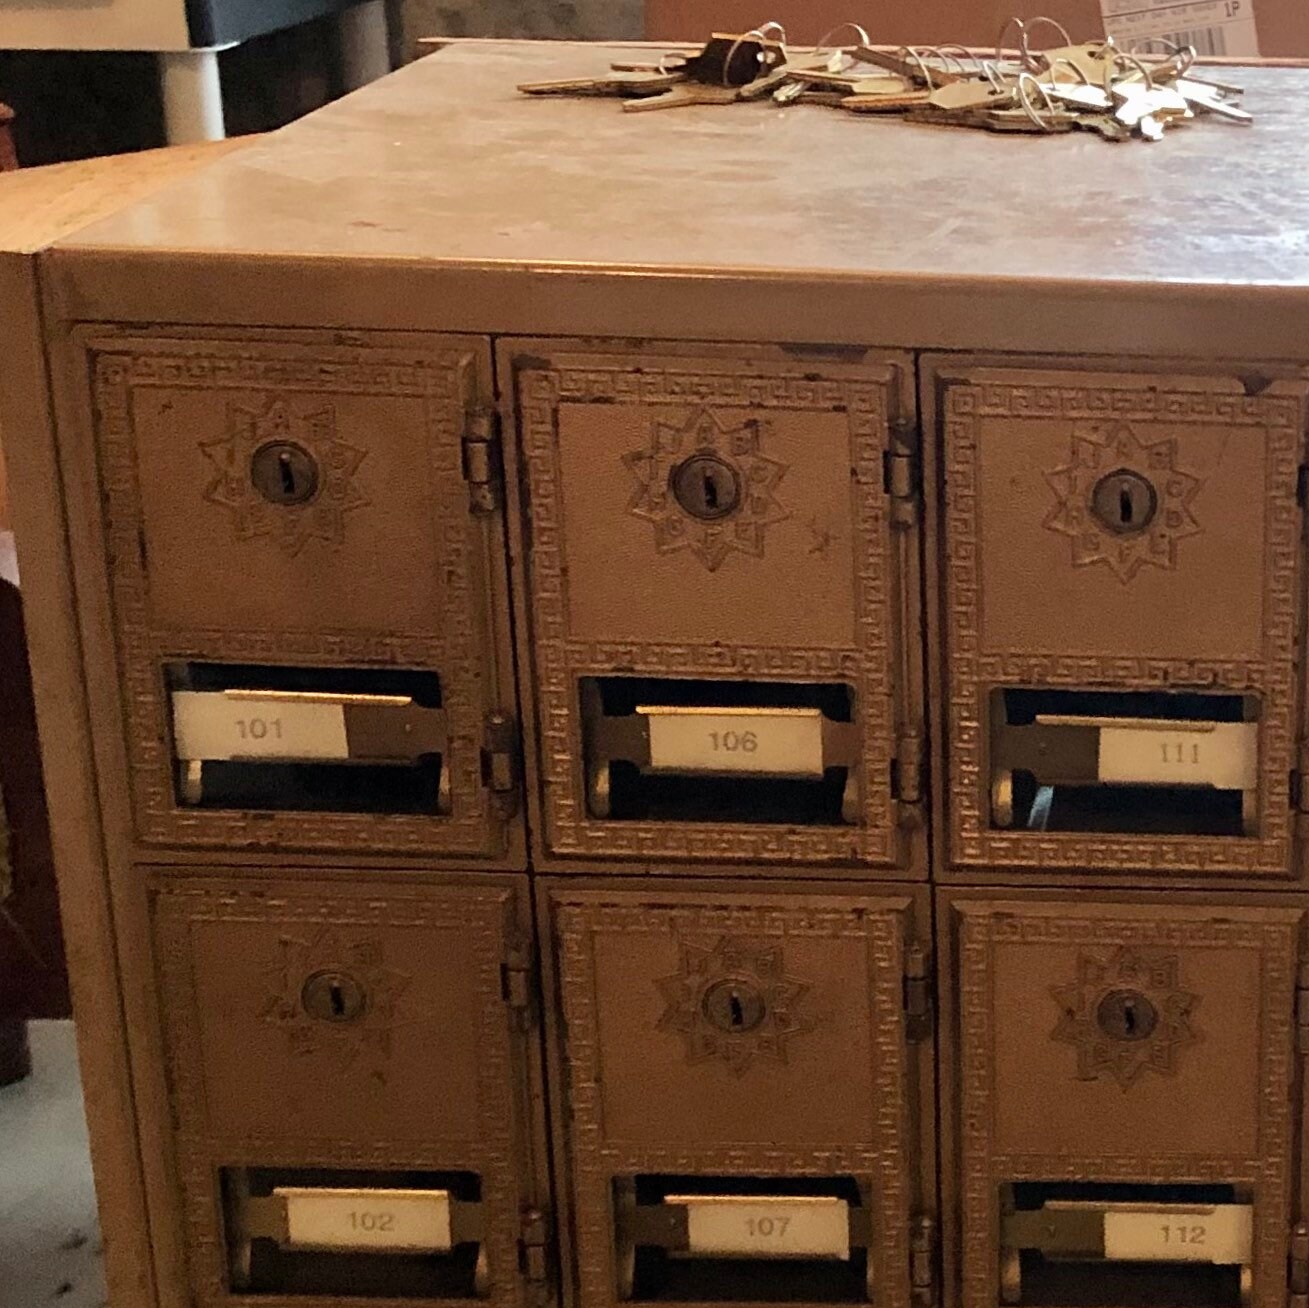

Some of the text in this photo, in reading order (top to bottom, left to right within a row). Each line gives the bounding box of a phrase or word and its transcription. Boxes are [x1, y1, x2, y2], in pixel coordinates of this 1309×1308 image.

[236, 718, 282, 739] 101
[709, 731, 758, 752] 106
[1161, 743, 1199, 764] 111
[348, 1211, 394, 1232] 102
[745, 1217, 790, 1237] 107
[1160, 1225, 1206, 1244] 112
